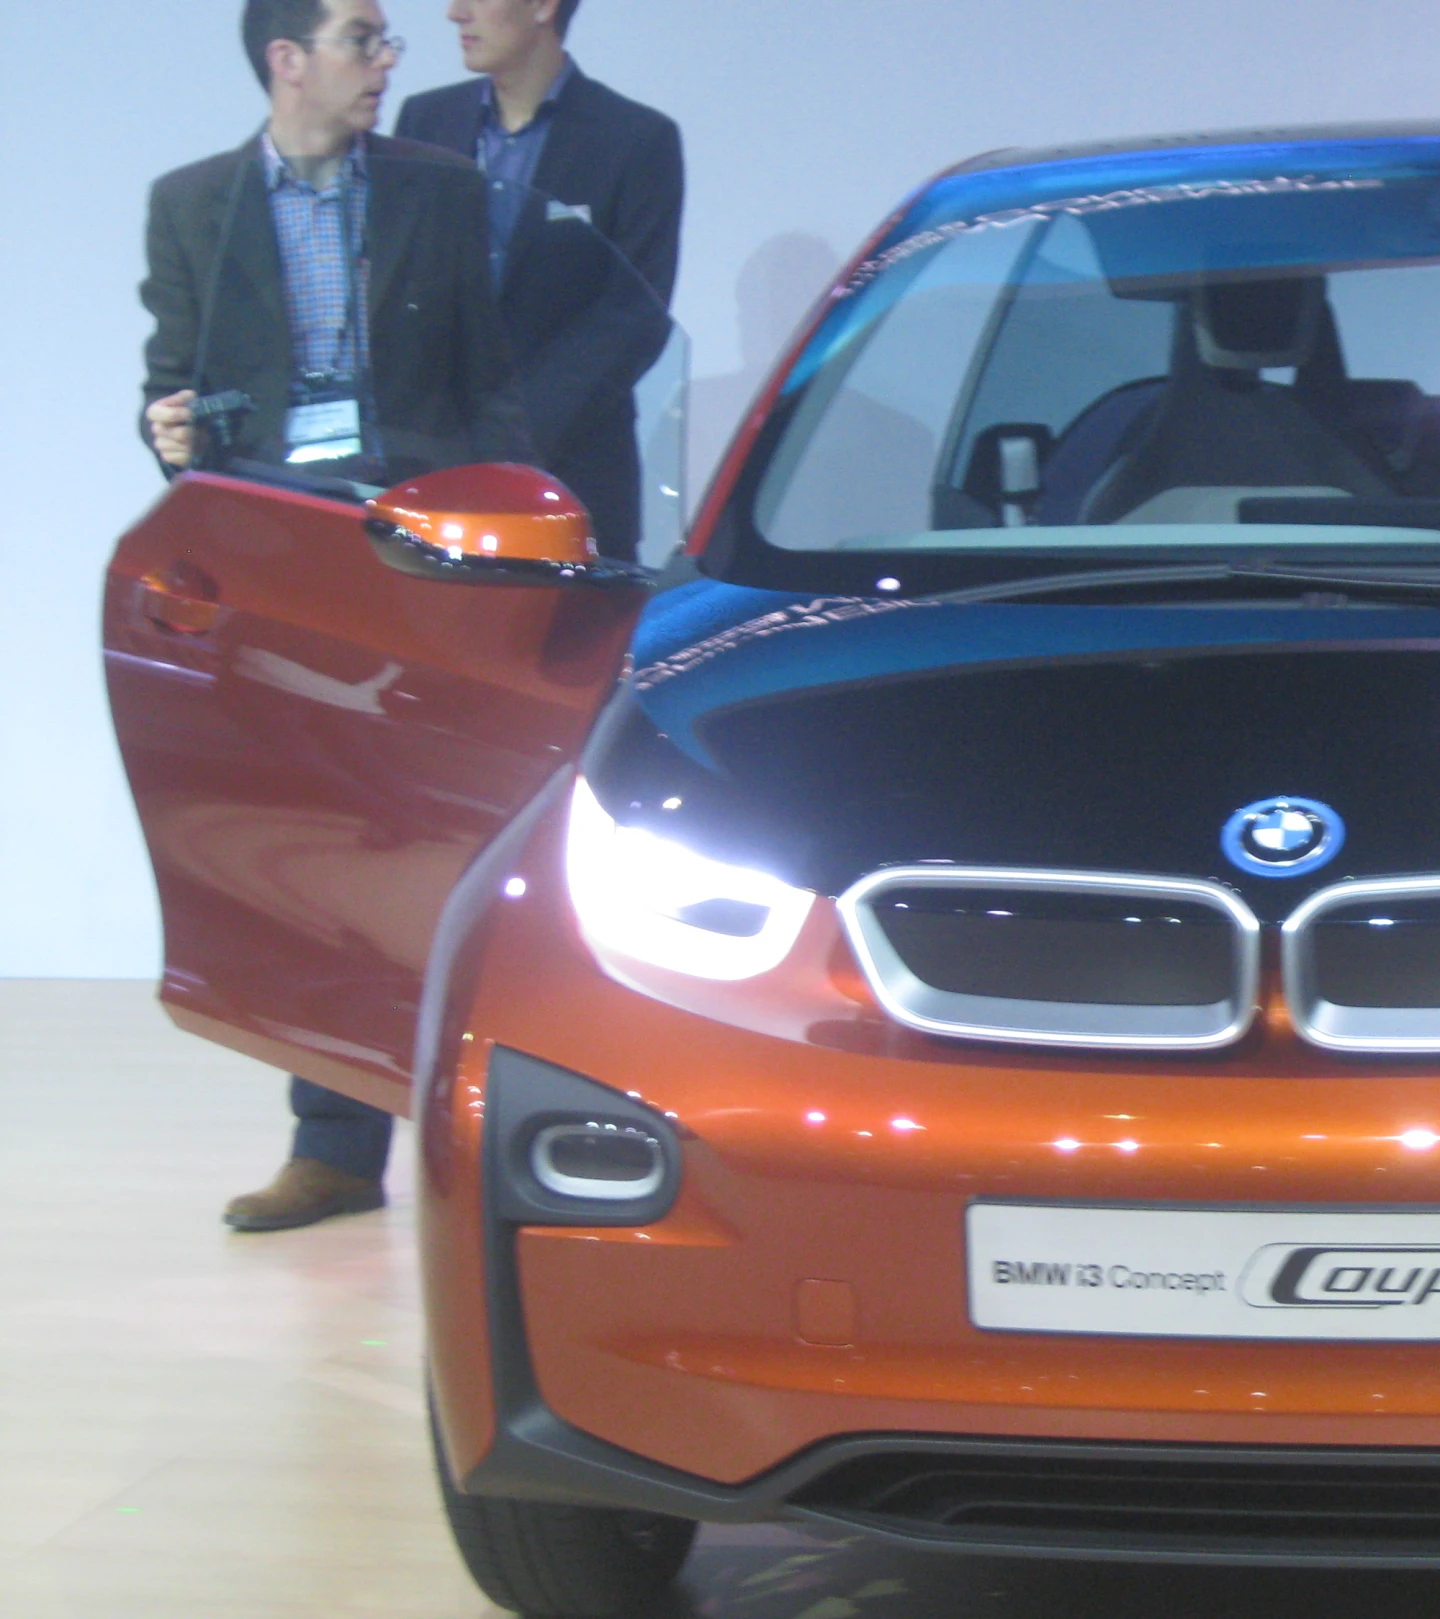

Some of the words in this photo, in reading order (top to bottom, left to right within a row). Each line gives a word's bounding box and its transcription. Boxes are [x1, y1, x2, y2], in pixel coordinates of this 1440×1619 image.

[992, 1259, 1072, 1286] BMW
[1076, 1262, 1103, 1289] i3
[1108, 1263, 1228, 1297] Concept
